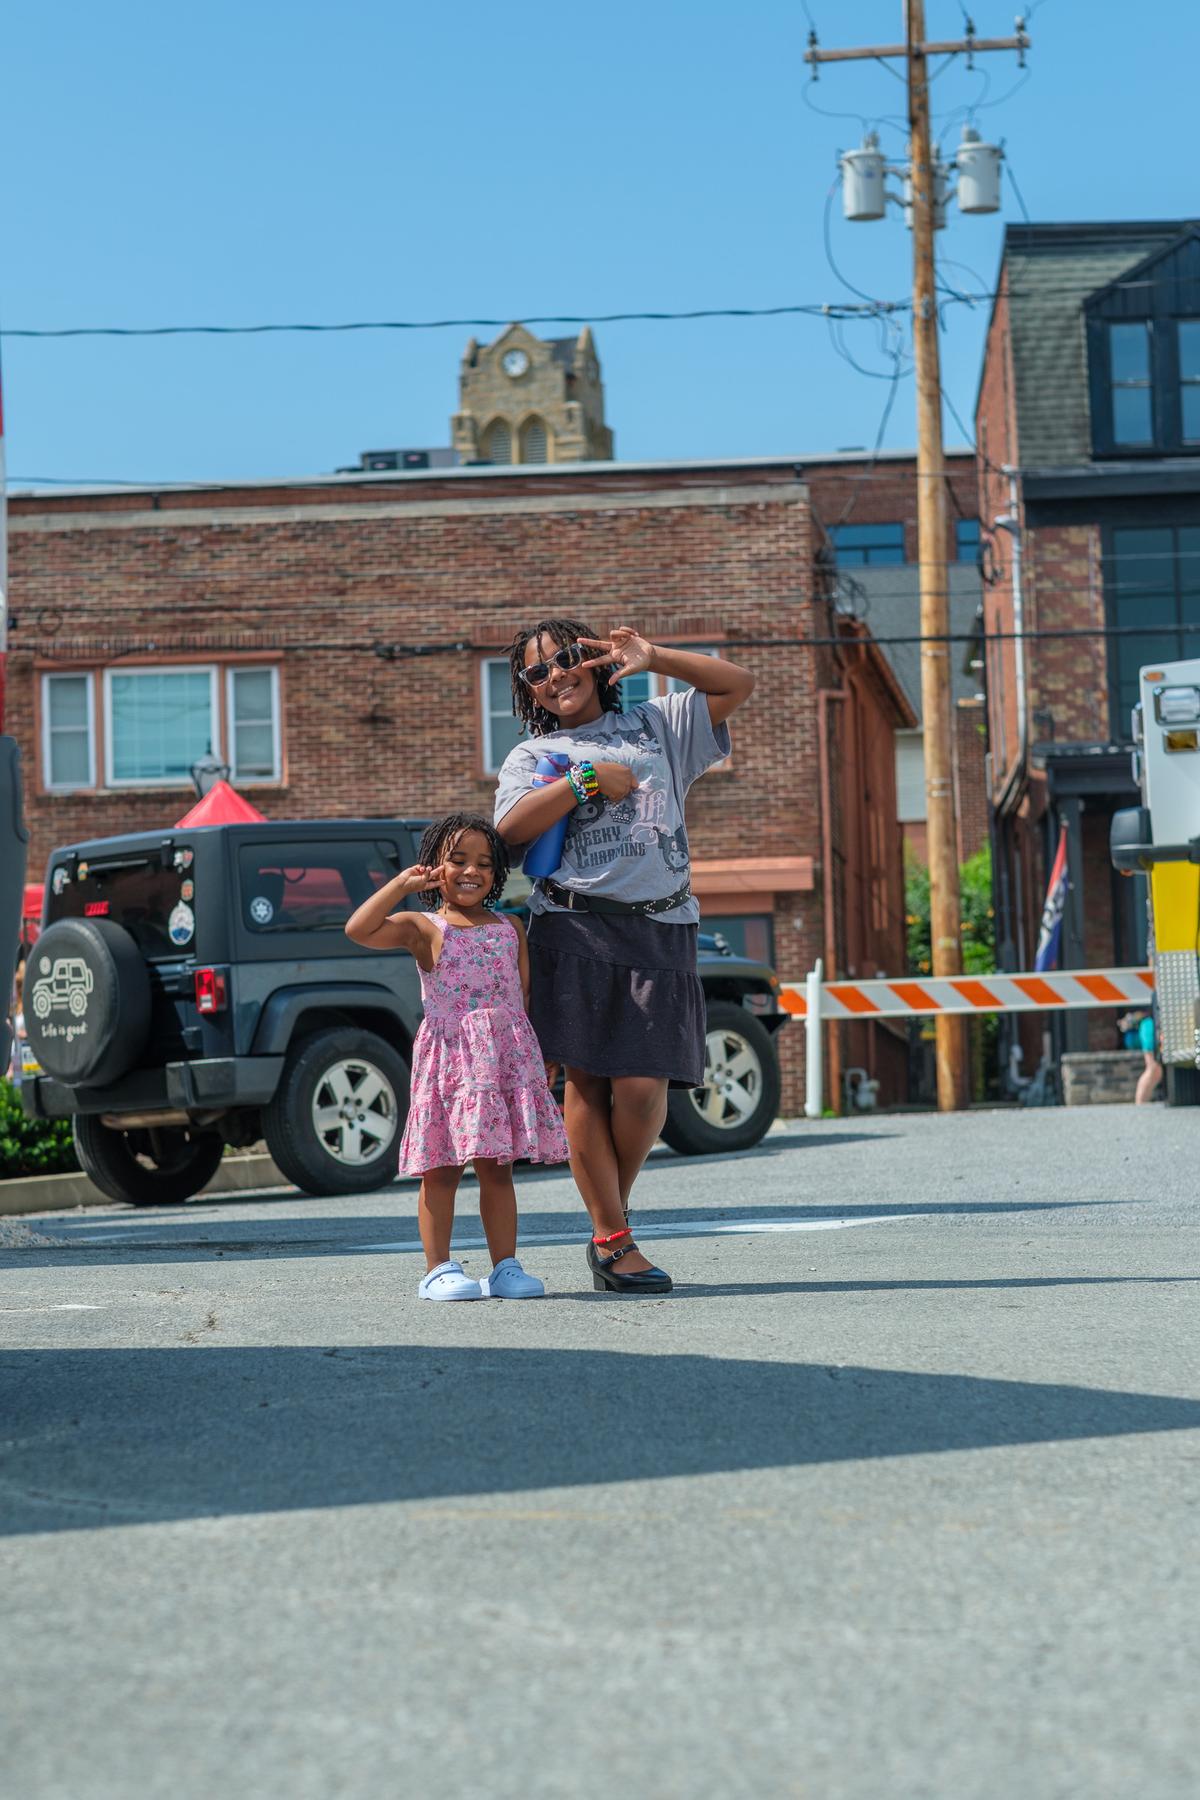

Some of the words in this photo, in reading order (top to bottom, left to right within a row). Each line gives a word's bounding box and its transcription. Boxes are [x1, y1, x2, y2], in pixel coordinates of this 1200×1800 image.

[41, 1022, 57, 1038] Life
[58, 1023, 66, 1037] is
[66, 1020, 86, 1042] good
